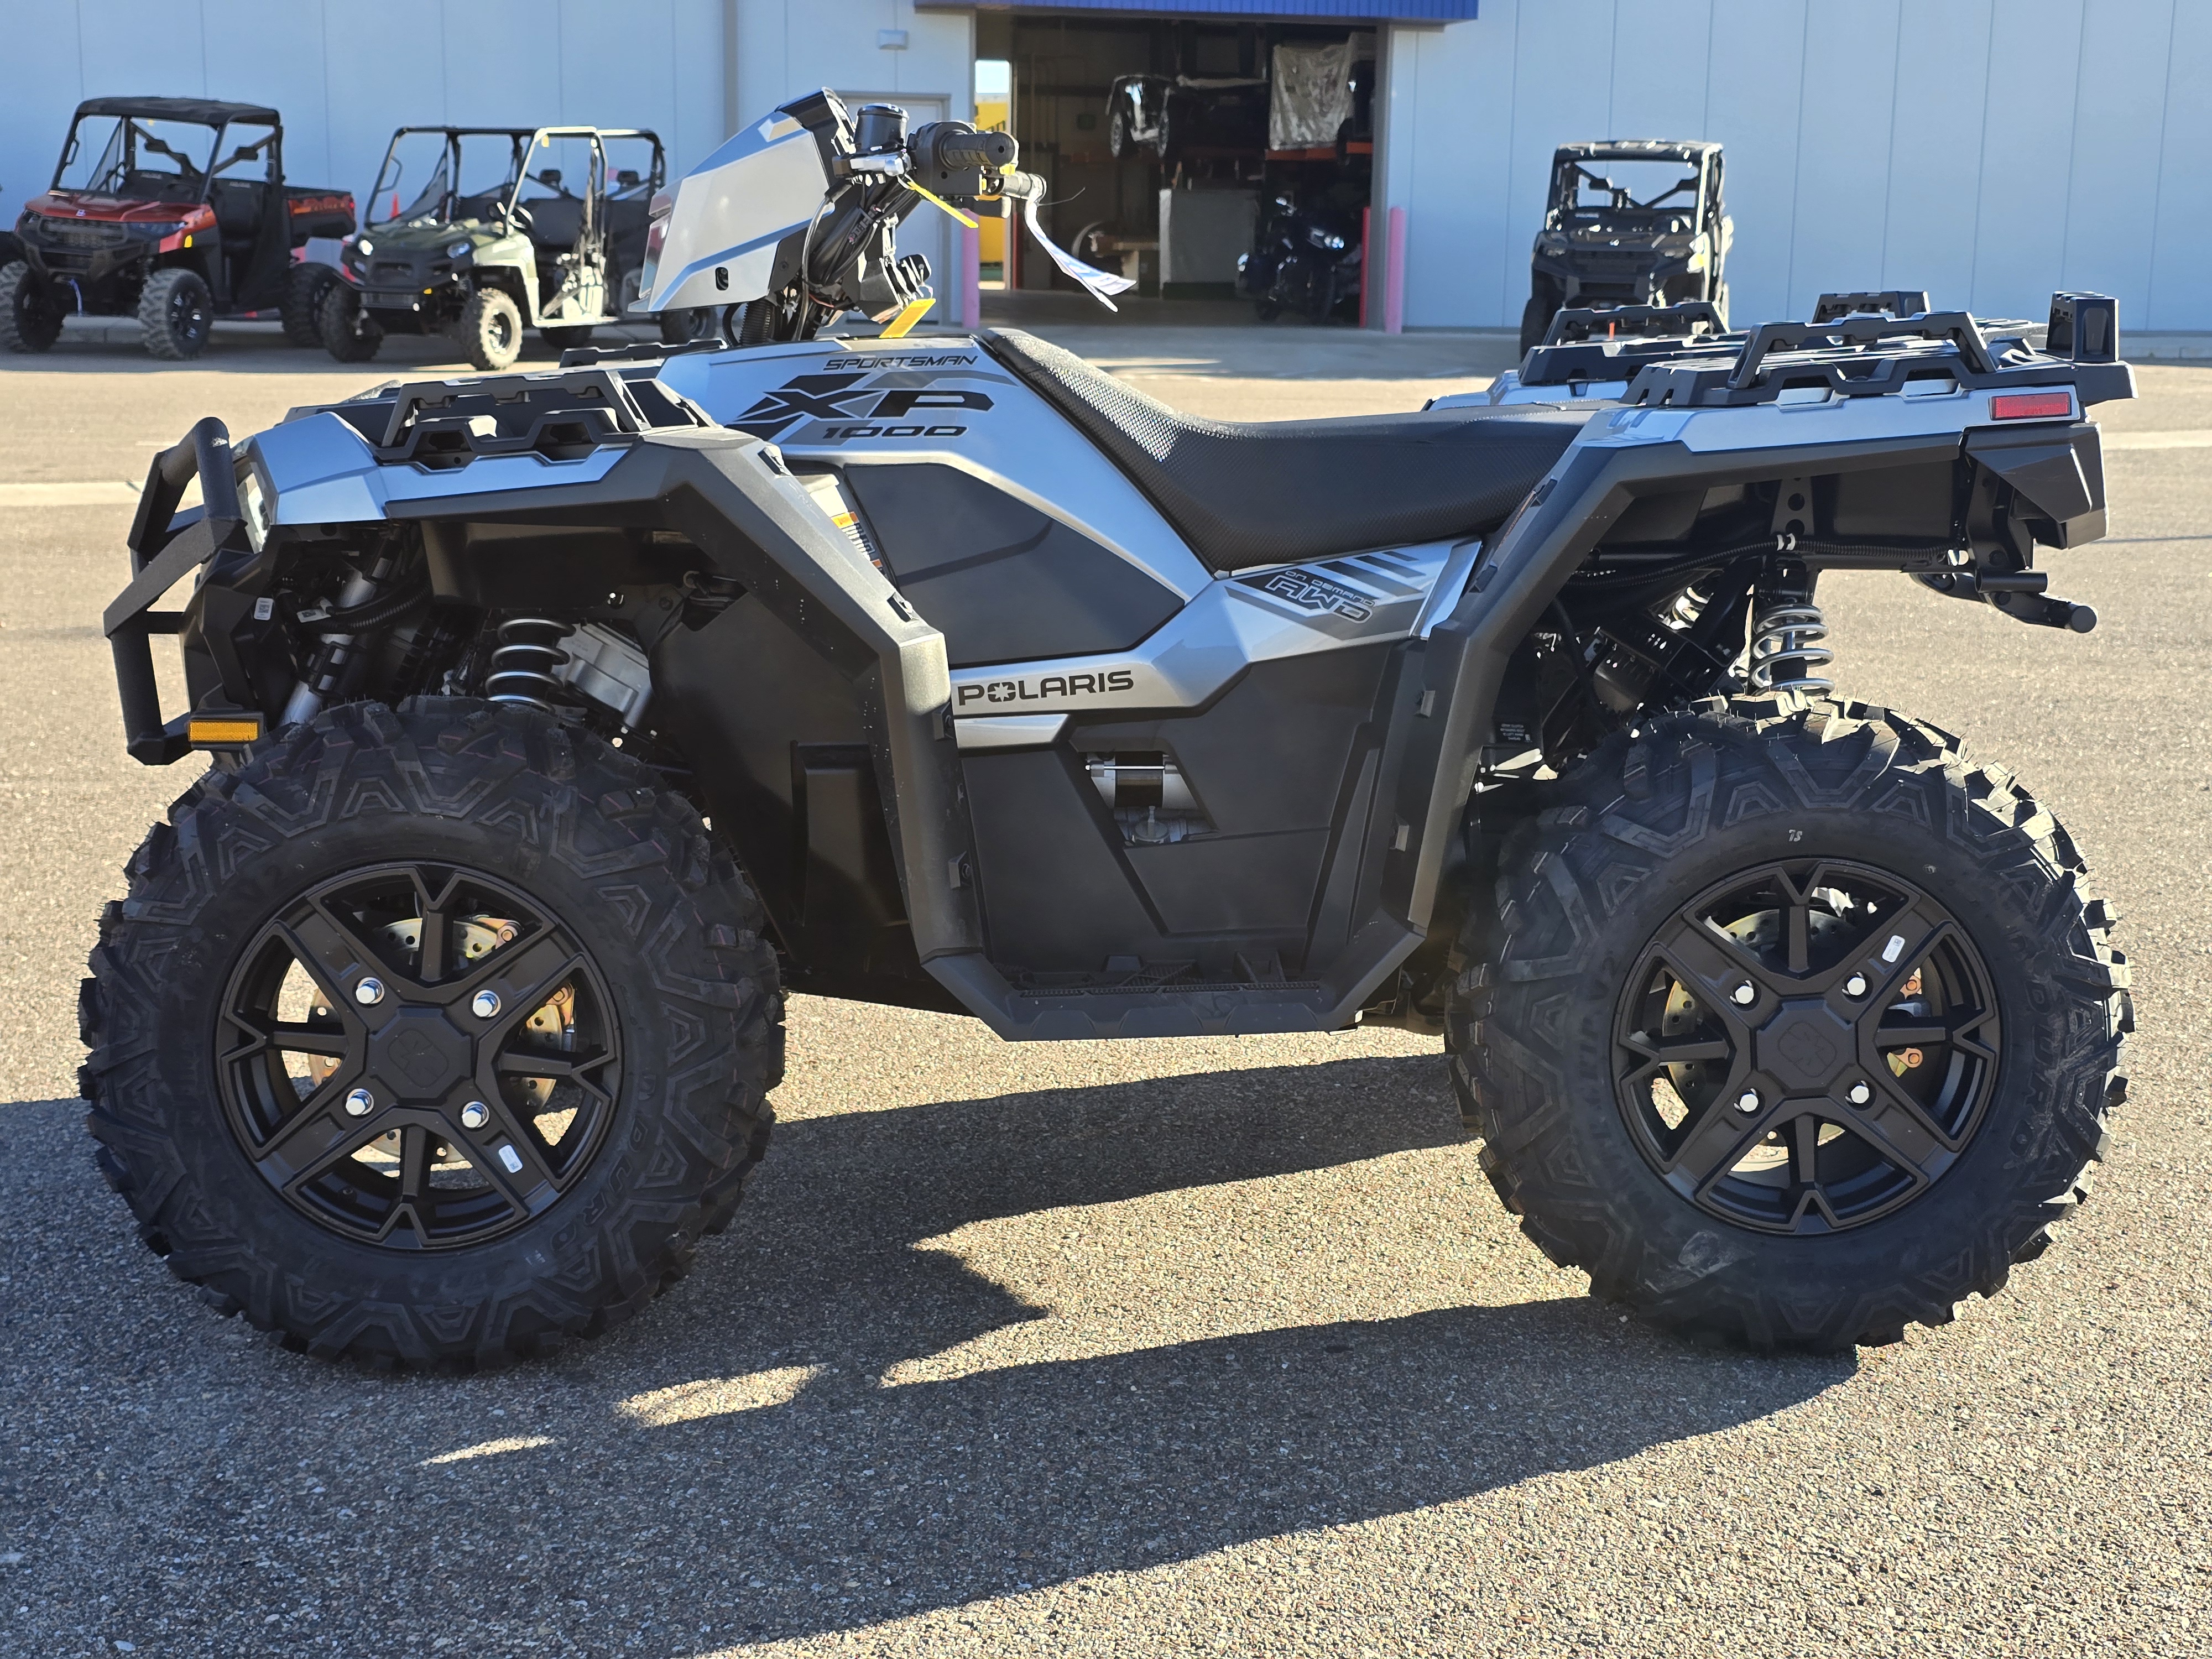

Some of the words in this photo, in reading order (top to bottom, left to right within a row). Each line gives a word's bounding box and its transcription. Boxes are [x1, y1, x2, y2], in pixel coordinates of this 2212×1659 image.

[823, 355, 978, 371] SPORTSMAN
[726, 372, 995, 441] XP
[822, 426, 968, 439] 1000
[1265, 575, 1373, 624] AWD
[957, 670, 1134, 706] POLARIS
[549, 1117, 649, 1252] DURO
